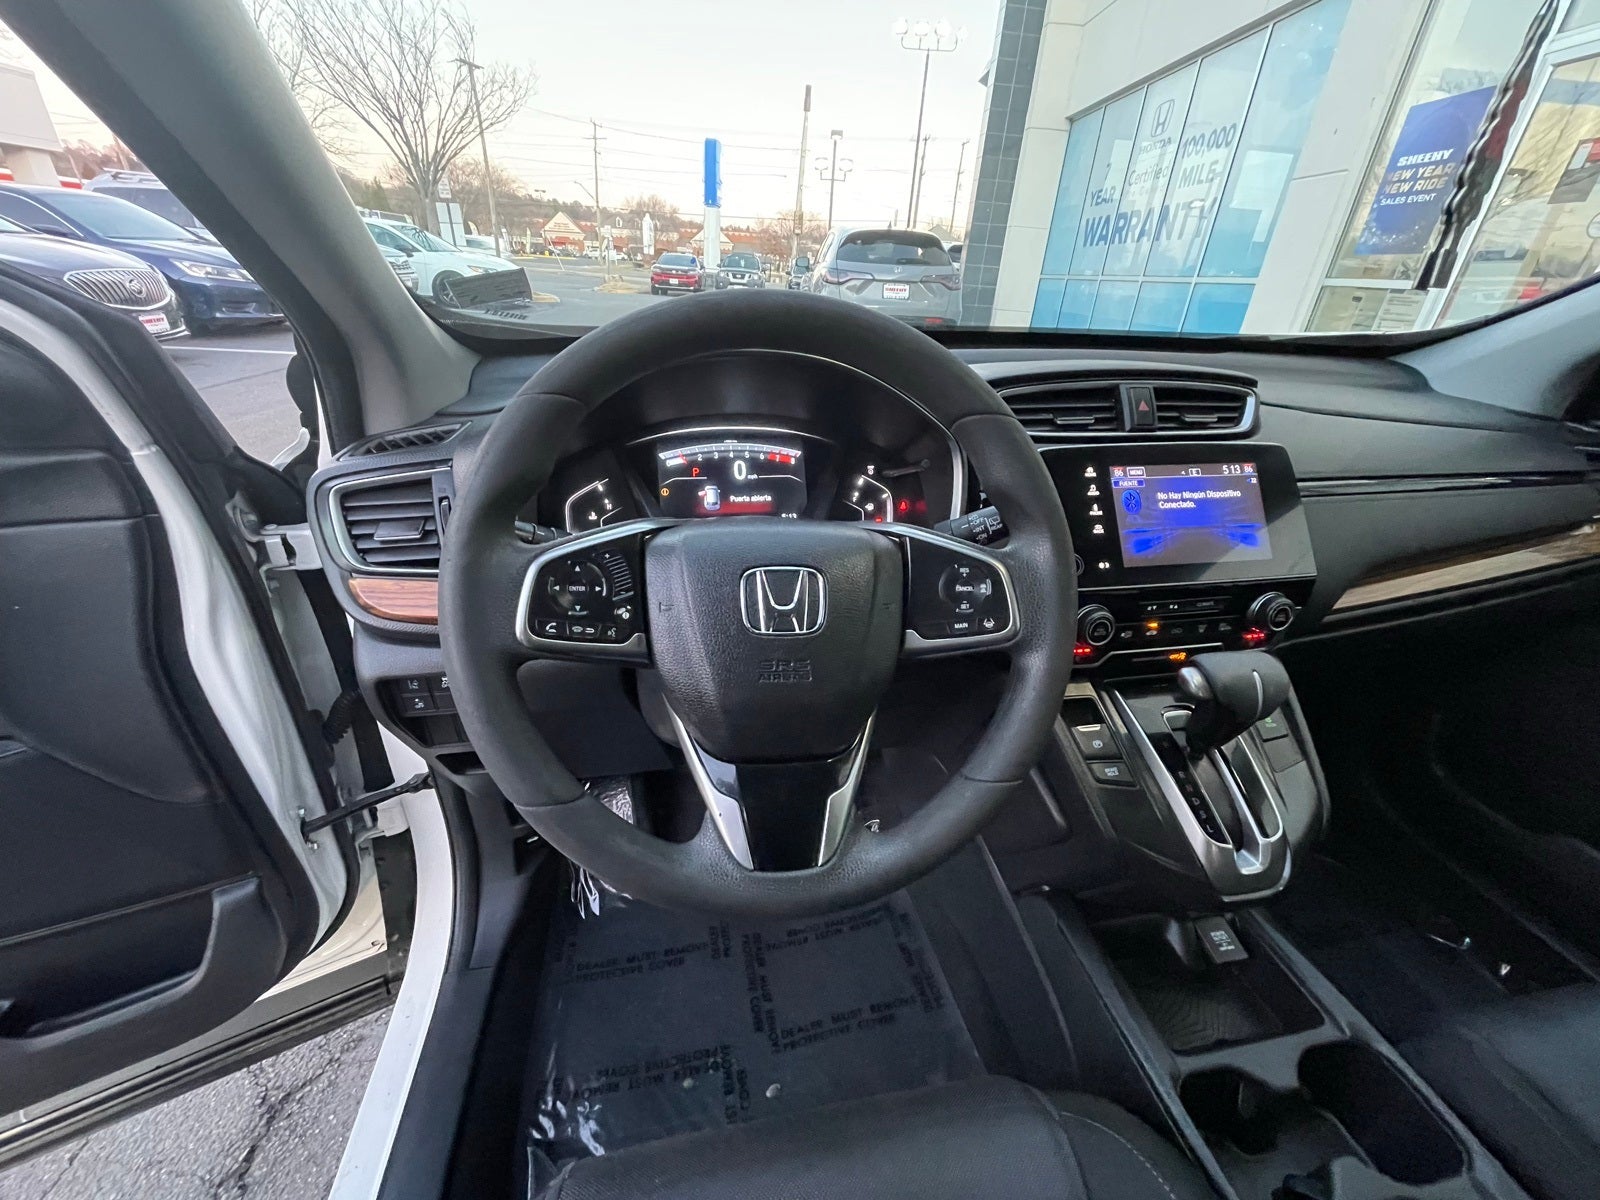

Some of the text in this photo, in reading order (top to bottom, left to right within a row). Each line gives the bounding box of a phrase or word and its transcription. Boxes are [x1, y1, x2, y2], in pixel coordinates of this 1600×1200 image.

[1182, 123, 1237, 159] 100,000
[1397, 149, 1454, 166] SHEEHY
[1129, 163, 1169, 187] Certified
[1179, 160, 1219, 189] MILE
[1413, 177, 1448, 191] RIDE
[1090, 186, 1116, 207] YEAR
[1380, 193, 1437, 206] SALES EVENT
[1083, 197, 1218, 247] WARRANTY
[692, 467, 700, 477] P
[733, 460, 746, 480] 0
[1244, 465, 1253, 473] 86
[750, 494, 772, 502] abierta
[1157, 492, 1167, 500] No
[1169, 491, 1181, 500] Hay
[1206, 489, 1241, 499] Dispositivo
[1158, 501, 1196, 509] Conectado.
